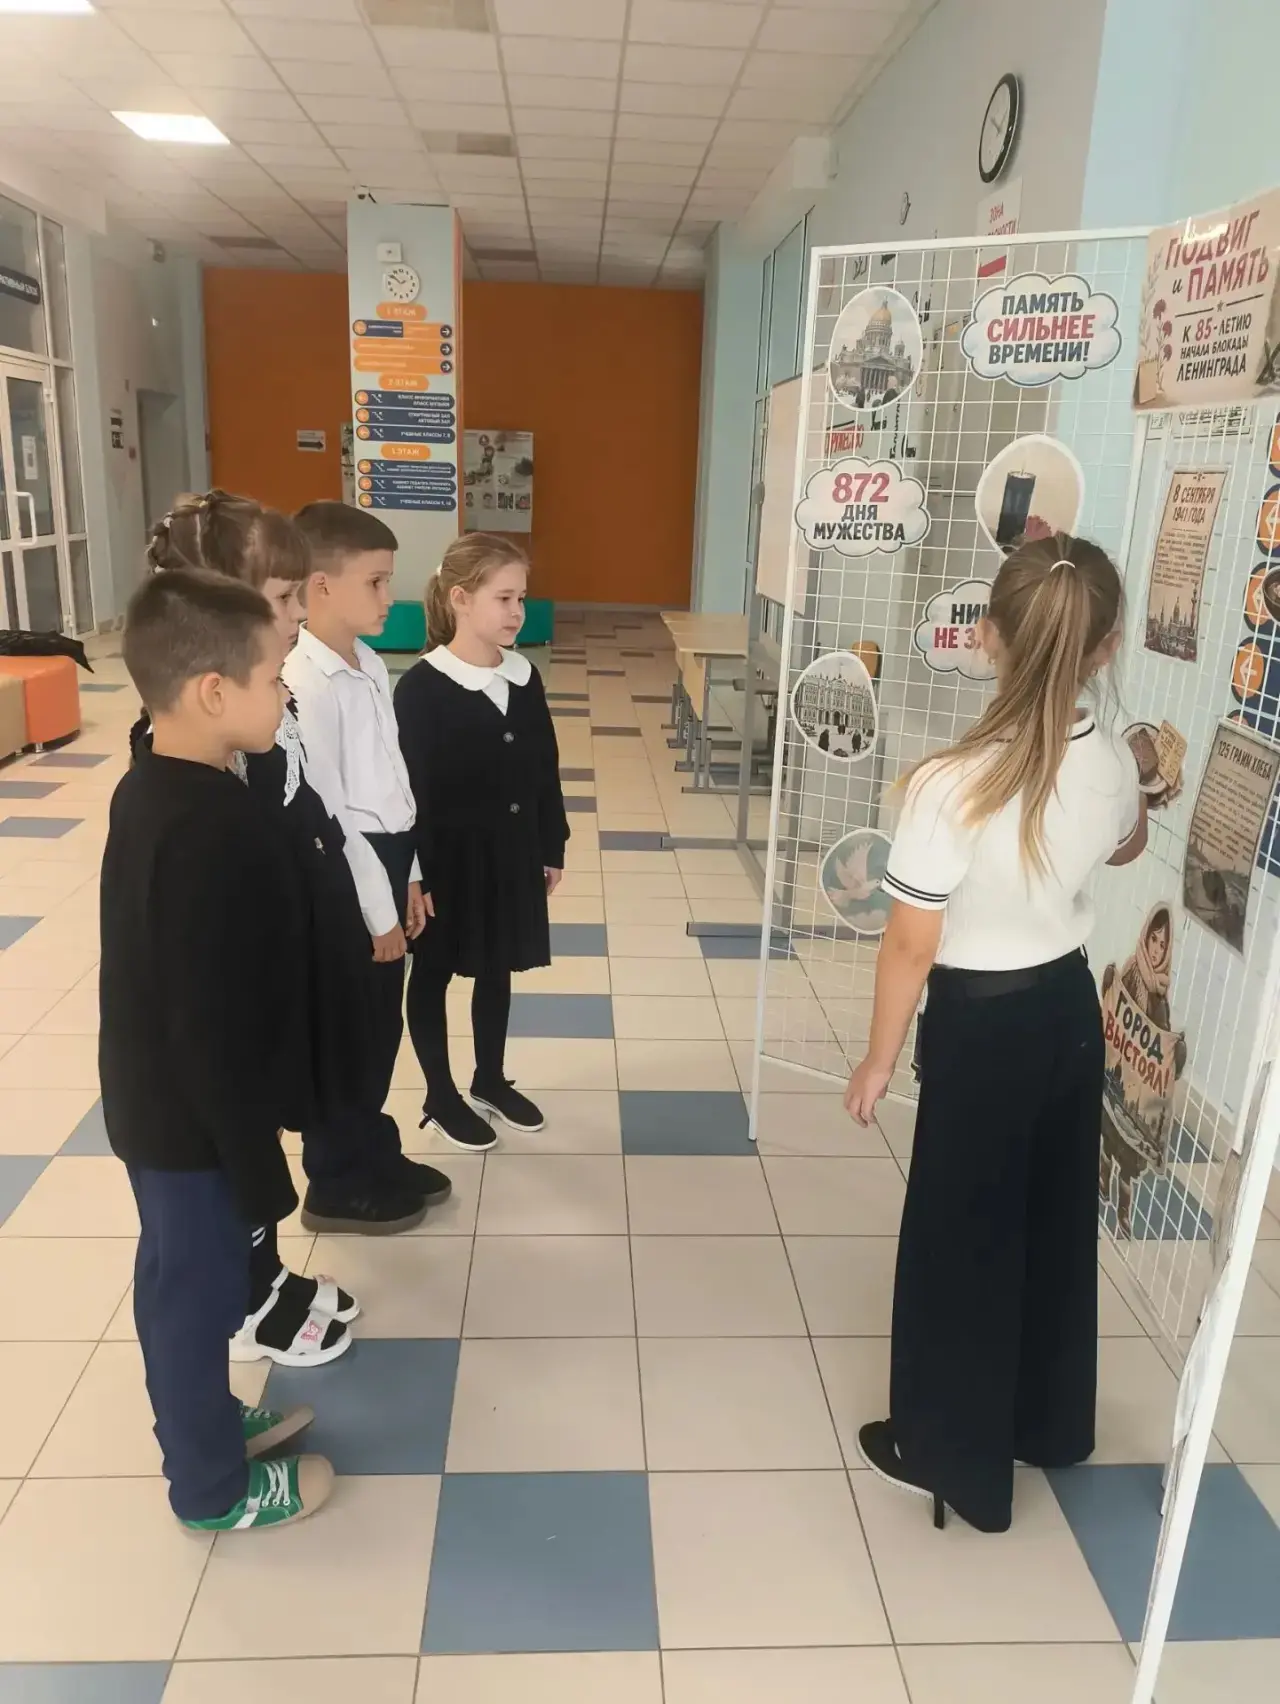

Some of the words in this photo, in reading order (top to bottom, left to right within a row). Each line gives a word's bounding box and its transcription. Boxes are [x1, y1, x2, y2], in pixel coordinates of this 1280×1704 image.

[1164, 210, 1260, 270] ПОДВИГ
[1172, 278, 1182, 295] и
[1187, 246, 1269, 302] ПАМЯТЬ
[1001, 292, 1084, 315] ПАМЯТЬ
[987, 314, 1096, 342] СИЛЬНЕЕ
[1182, 326, 1190, 344] К
[988, 341, 1090, 365] ВРЕМЕНИ!
[1180, 343, 1210, 359] НАЧАЛА
[1212, 335, 1249, 355] БЛОКАДЫ
[1176, 353, 1247, 382] ЛЕНИНГРАДА
[832, 472, 890, 504] 872
[1172, 484, 1181, 503] 8
[1181, 487, 1216, 504] СЕНТЯБРЯ
[841, 504, 878, 522] ДНЯ
[1172, 506, 1188, 522] 1941
[1188, 507, 1206, 524] ГОДА
[813, 522, 905, 541] МУЖЕСТВА
[934, 627, 960, 649] НЕ
[1217, 740, 1231, 759] 125
[1229, 745, 1252, 770] ГРАММ
[1250, 755, 1273, 781] ХЛЕБА
[1115, 990, 1163, 1065] ГОРОД
[1105, 1010, 1169, 1099] ВЫСТОЯЛ!
